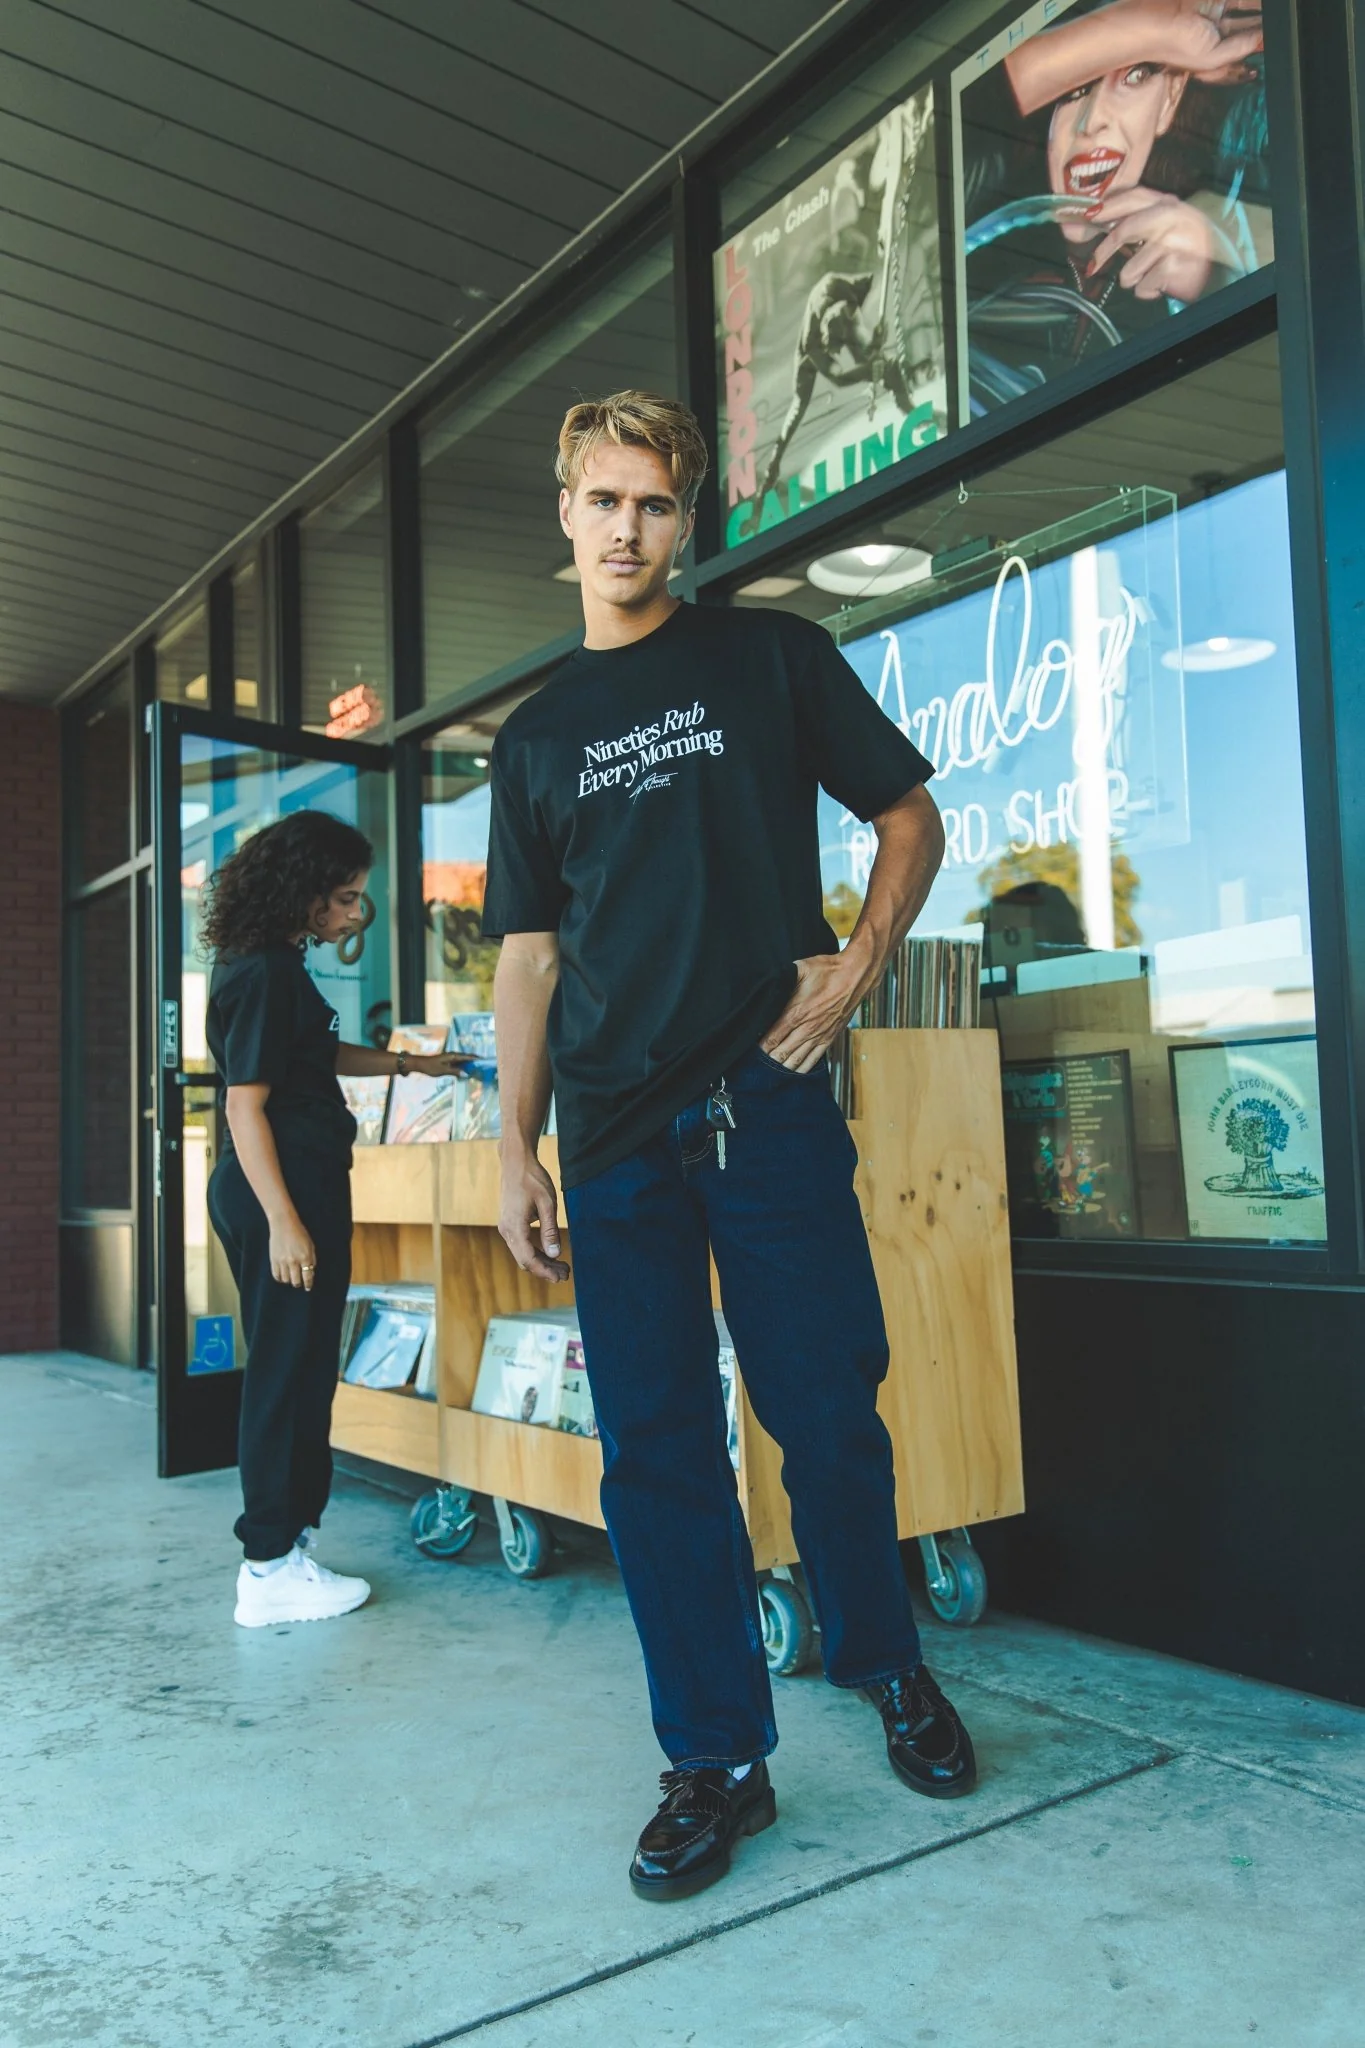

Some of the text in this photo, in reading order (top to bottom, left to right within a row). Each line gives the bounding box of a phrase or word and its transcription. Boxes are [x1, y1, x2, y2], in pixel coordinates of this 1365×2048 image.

[976, 0, 1059, 69] THE
[752, 186, 830, 258] The Clash
[724, 245, 758, 508] LONDON
[726, 400, 938, 549] CALLING
[578, 760, 639, 798] Every
[638, 728, 724, 773] Morning
[584, 701, 705, 768] Nineties Rnb
[1207, 1106, 1221, 1133] JOHN
[1275, 1087, 1301, 1111] MUST
[1296, 1112, 1310, 1131] DIE
[1246, 1206, 1283, 1217] TRAFFIC
